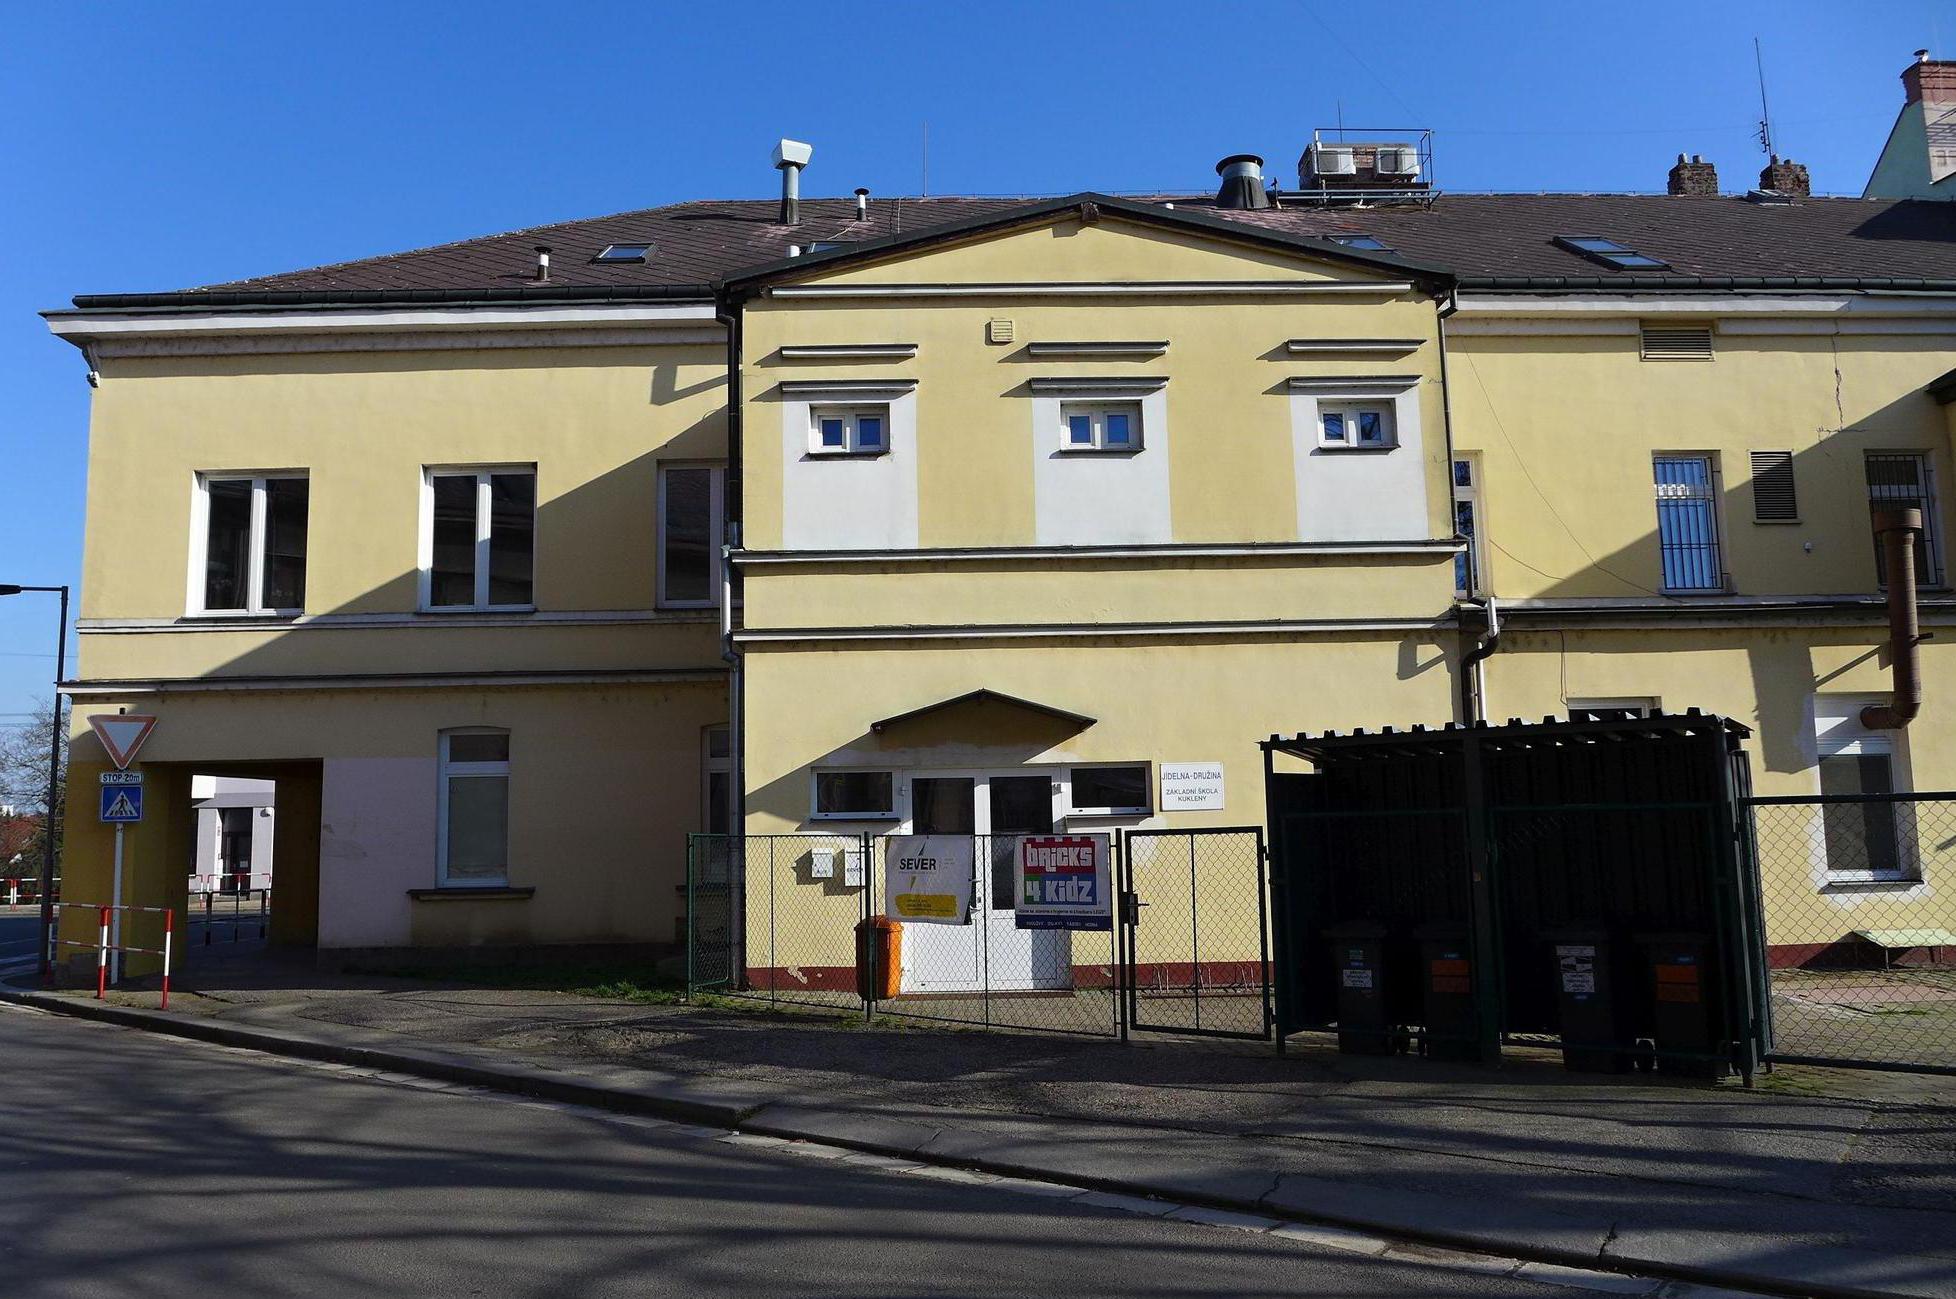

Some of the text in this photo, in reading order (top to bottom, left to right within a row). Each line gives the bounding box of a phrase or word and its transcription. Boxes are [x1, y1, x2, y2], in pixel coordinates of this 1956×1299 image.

[1198, 787, 1219, 795] ŠKOLA
[899, 858, 937, 871] SEVER
[1026, 880, 1041, 902] 4
